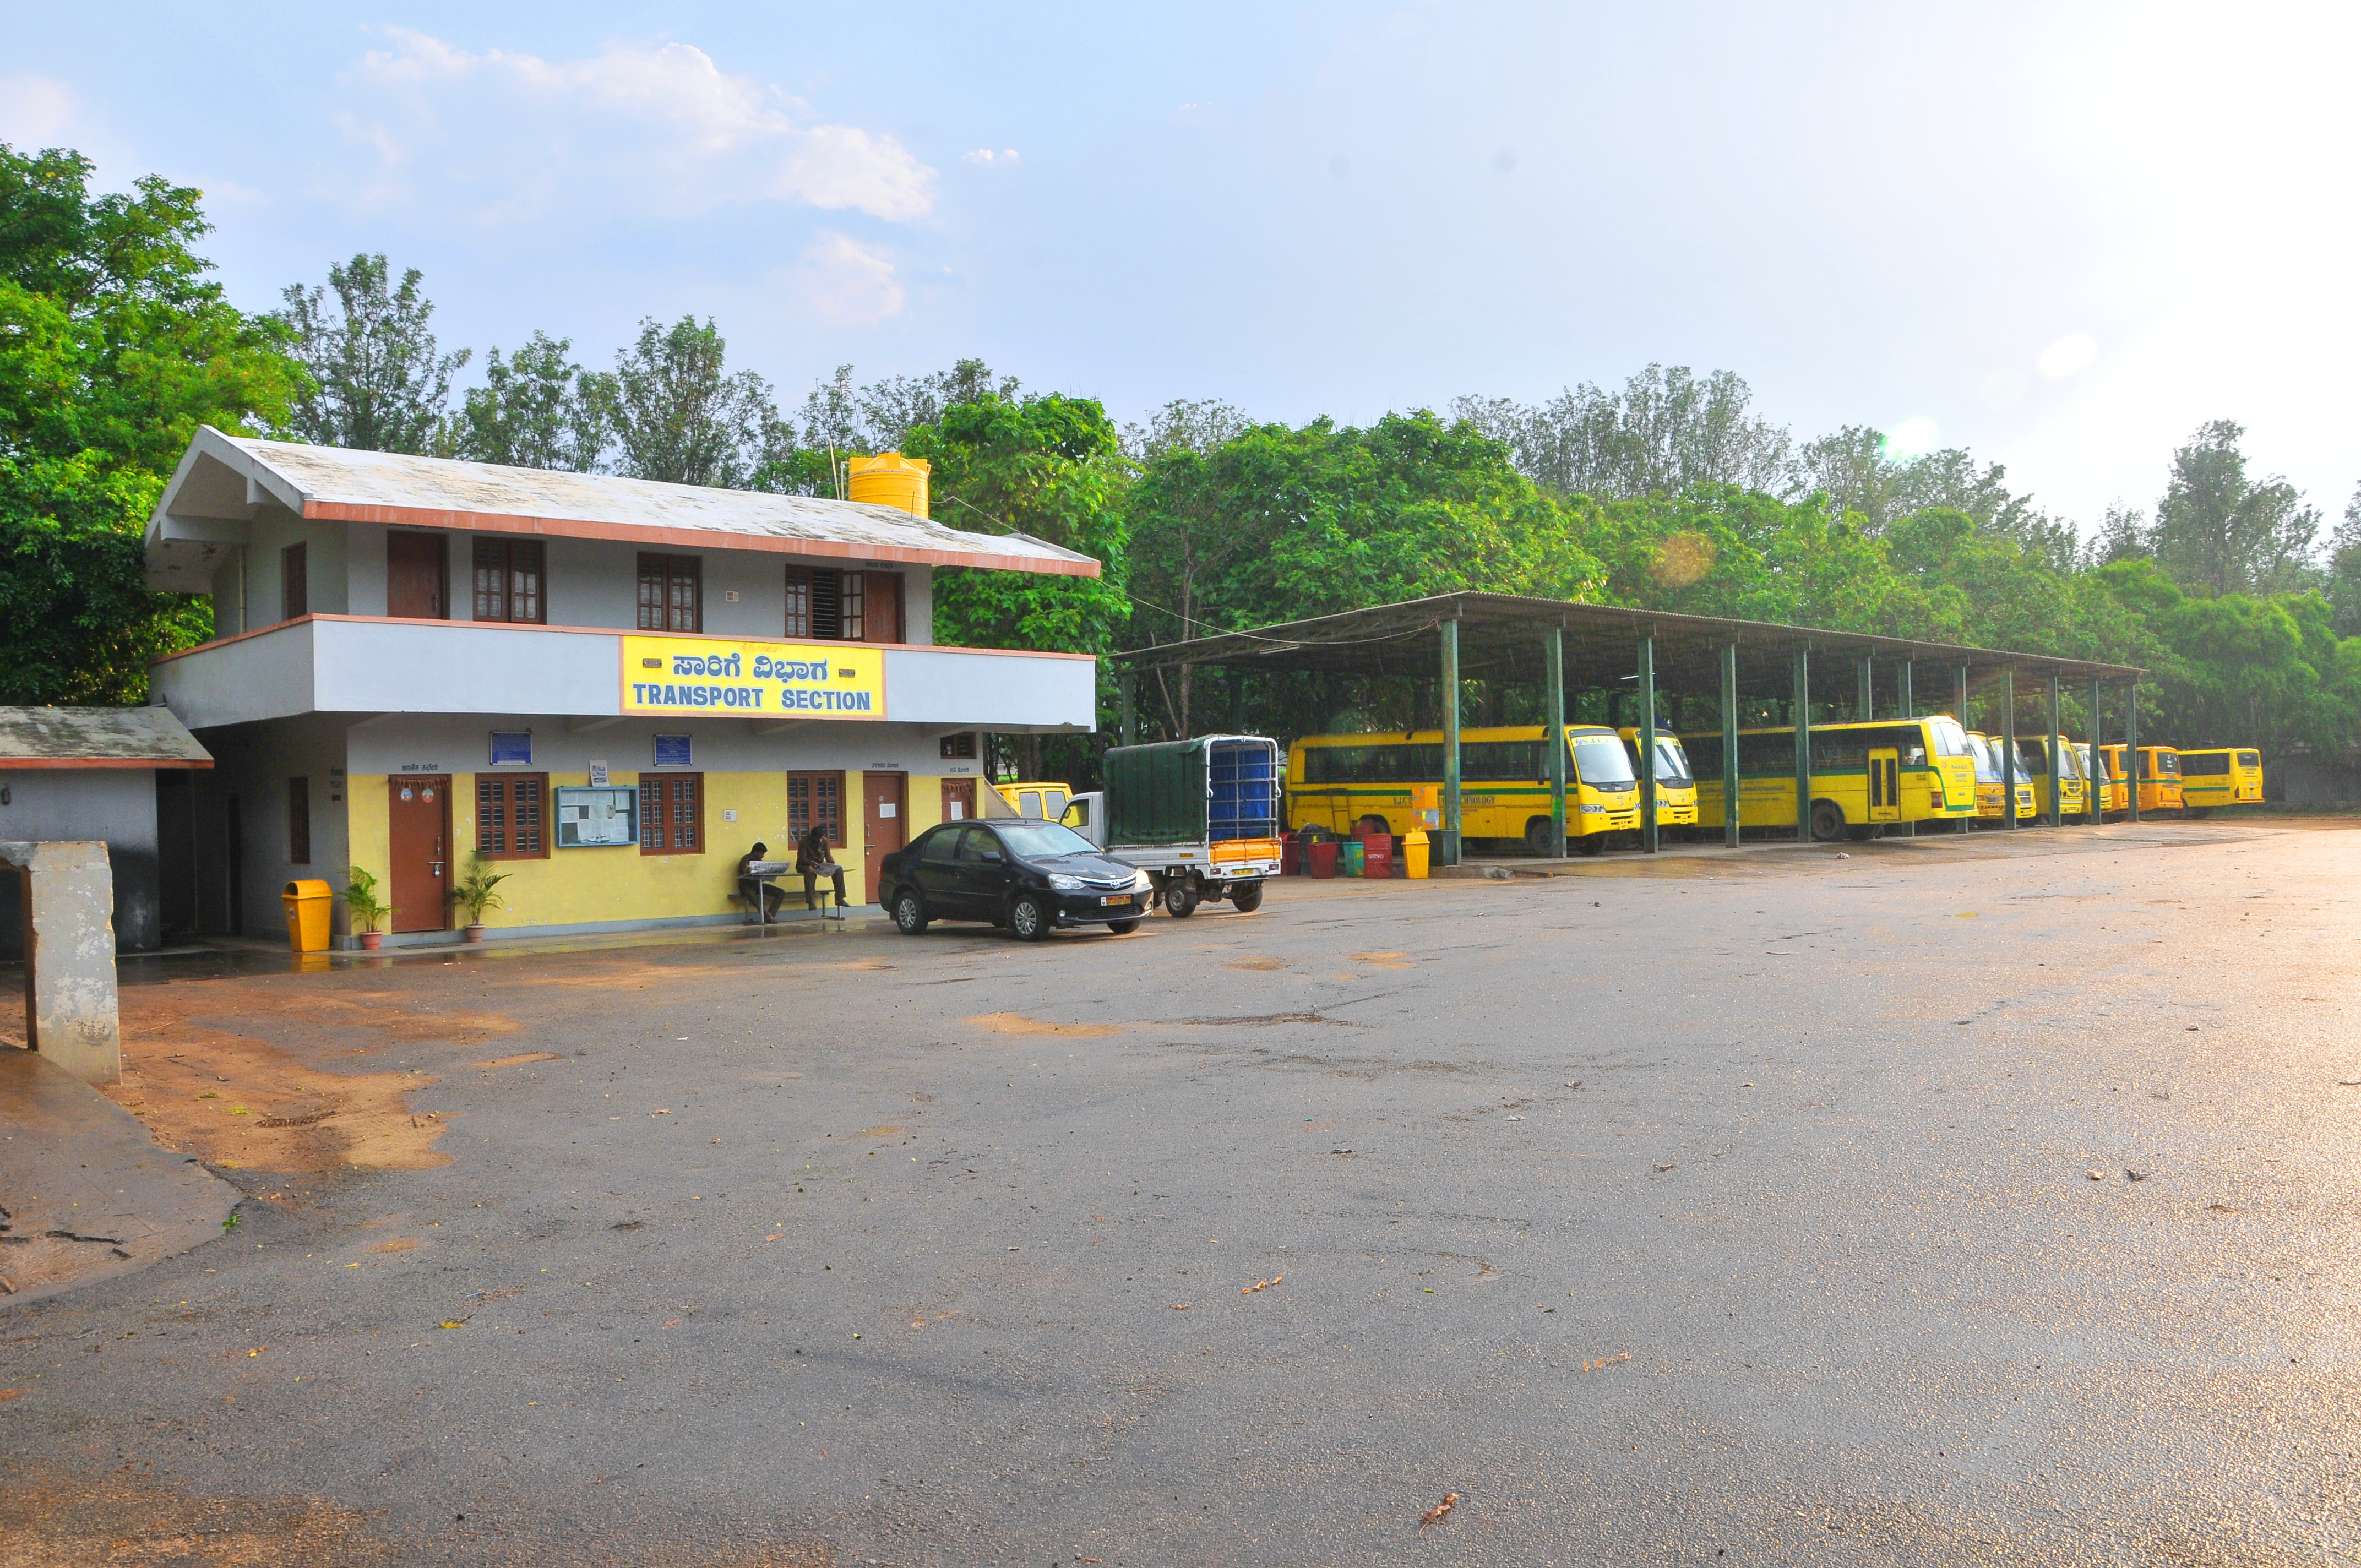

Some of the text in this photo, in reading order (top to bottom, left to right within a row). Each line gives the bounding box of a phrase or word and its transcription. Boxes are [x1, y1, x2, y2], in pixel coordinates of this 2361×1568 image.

[673, 652, 828, 684] ಸಾರಿಗೆ ವಿಭಾಗ
[633, 683, 871, 711] TRANSPORT SECTION
[1461, 796, 1495, 804] CHNOLOGY
